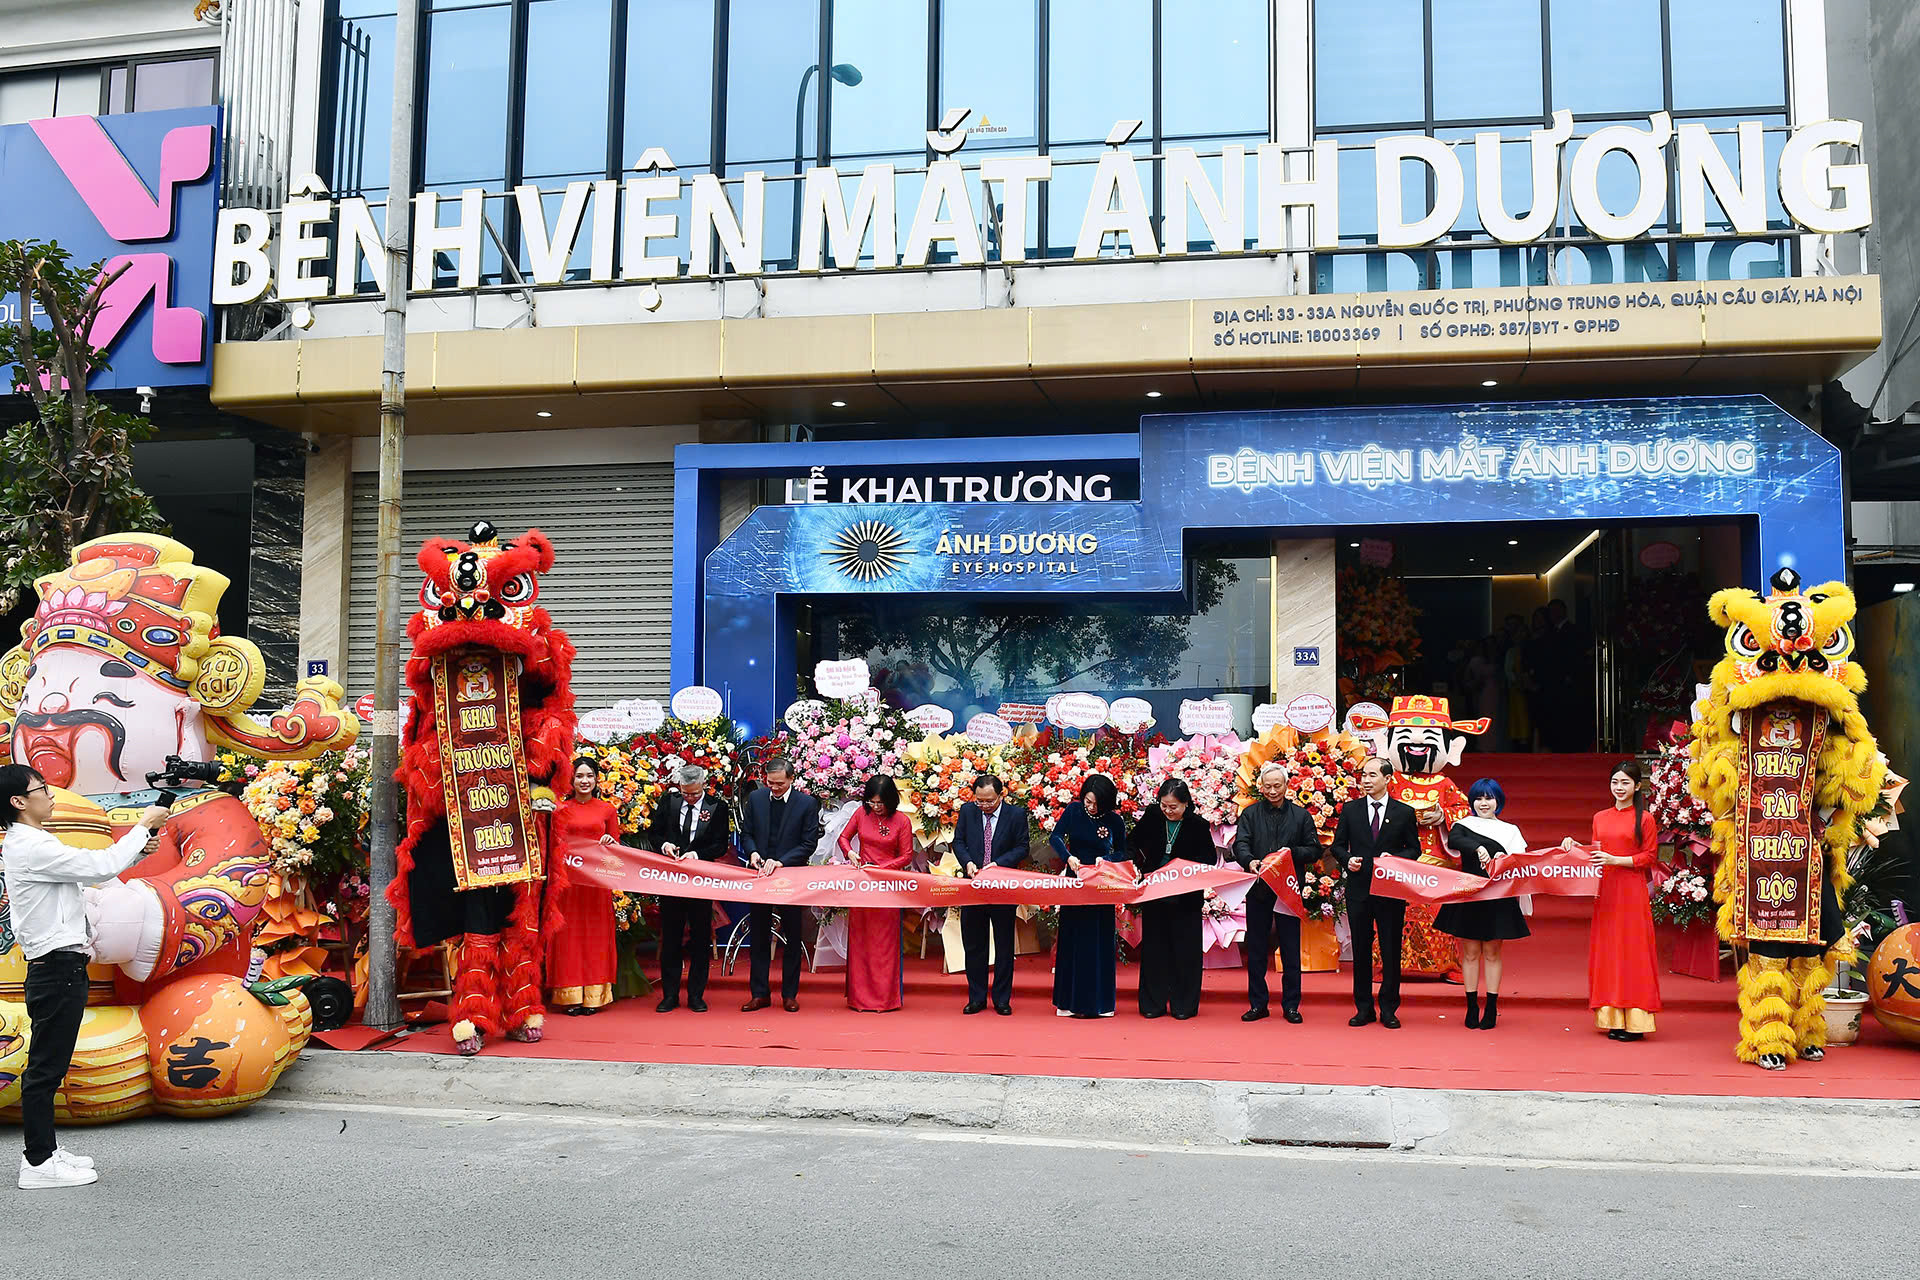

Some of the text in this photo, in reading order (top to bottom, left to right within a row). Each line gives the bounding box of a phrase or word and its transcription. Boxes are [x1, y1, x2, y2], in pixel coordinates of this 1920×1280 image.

[212, 107, 1874, 331] BỆNH VIỆN MẮT ÁNH DƯƠNG
[1213, 309, 1240, 326] ĐỊA
[1243, 304, 1273, 323] CHỈ:
[1276, 308, 1295, 321] 33
[1306, 305, 1336, 320] 33A
[1340, 299, 1404, 319] NGUYỄN
[1408, 297, 1458, 316] QUỐC
[1463, 299, 1489, 317] TRỊ,
[1493, 295, 1563, 313] PHƯỜNG
[1567, 295, 1621, 311] TRUNG
[1626, 291, 1666, 309] HÒA,
[1671, 289, 1718, 309] QUẬN
[1722, 287, 1757, 305] CẦU
[1761, 285, 1801, 305] GIẤY,
[1804, 286, 1828, 303] HÀ
[1832, 285, 1863, 305] NỘI
[1213, 329, 1235, 346] SỐ
[1239, 330, 1303, 345] HOTLINE:
[1306, 327, 1381, 343] 18003369
[1420, 322, 1441, 339] SỐ
[1446, 323, 1495, 338] GPHĐ:
[1499, 320, 1559, 336] 387/BYT
[1573, 319, 1621, 333] GPHĐ
[1209, 436, 1755, 490] BỆNH VIỆN MẮT ÁNH DƯƠNG
[784, 465, 1112, 504] LỄ KHAI TRƯƠNG
[934, 529, 1098, 555] ÁNH DƯƠNG
[952, 560, 1079, 574] EYE HOSPITAL
[311, 663, 324, 674] 33
[1295, 651, 1318, 662] 33A
[460, 706, 496, 731] KHAI
[454, 743, 512, 774] TRƯƠNG
[1754, 750, 1803, 778] PHÁT
[467, 777, 509, 811] HỒNG
[1760, 790, 1798, 819] TÀI
[474, 818, 513, 851] PHÁT
[1750, 833, 1806, 862] PHÁT
[638, 867, 754, 891] GRAND OPENING
[806, 879, 919, 892] GRAND OPENING
[970, 877, 1085, 890] GRAND OPENING
[1374, 866, 1439, 888] OPENING
[1757, 875, 1796, 907] LỘC
[1881, 957, 1920, 1000] 大
[166, 1037, 231, 1090] 吉
